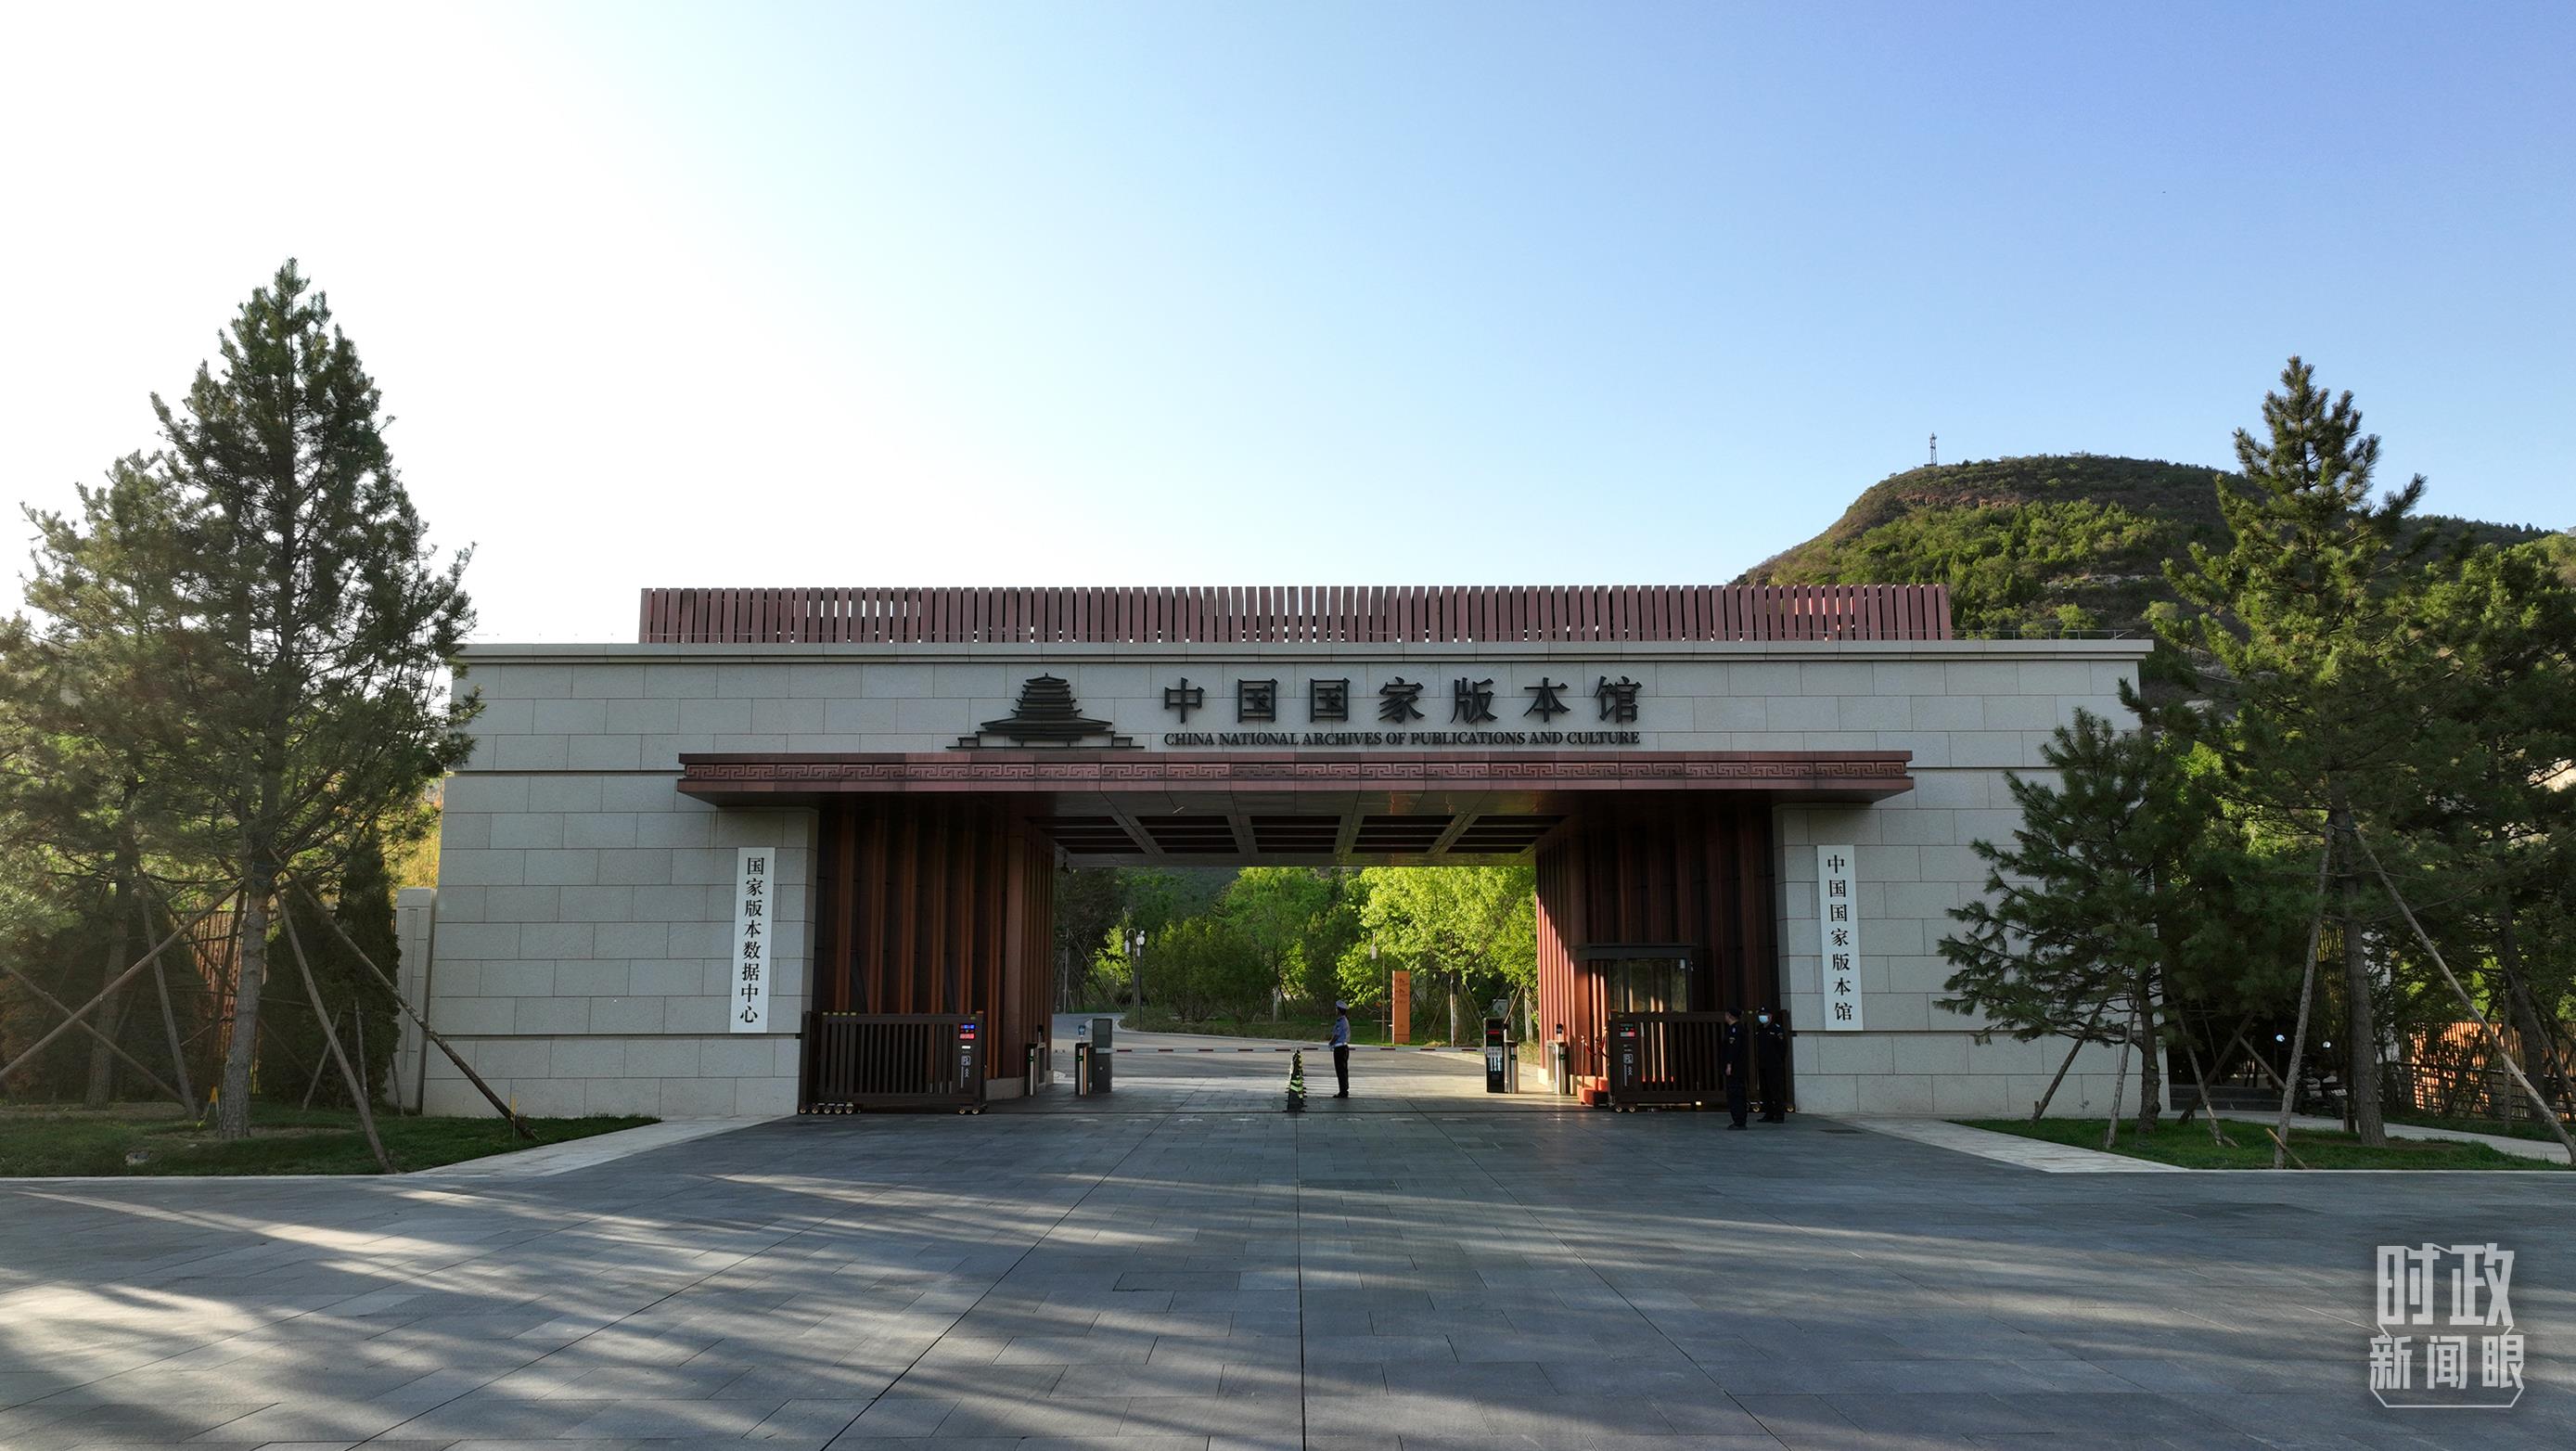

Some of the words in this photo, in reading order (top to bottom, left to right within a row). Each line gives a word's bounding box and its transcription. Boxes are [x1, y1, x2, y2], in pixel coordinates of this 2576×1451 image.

[1163, 732, 1215, 746] CHINA
[1219, 732, 1299, 746] NATIONAL
[1302, 732, 1382, 746] ARCHIVES
[1385, 732, 1406, 745] OF
[1410, 731, 1526, 745] PUBLICATIONS
[1529, 731, 1563, 745] AND
[1566, 731, 1641, 745] CULTURE
[1164, 676, 1642, 724] 中国国家版本馆
[739, 857, 765, 1023] 国家版本数据中心
[1827, 854, 1852, 1021] 中国国家版本馆
